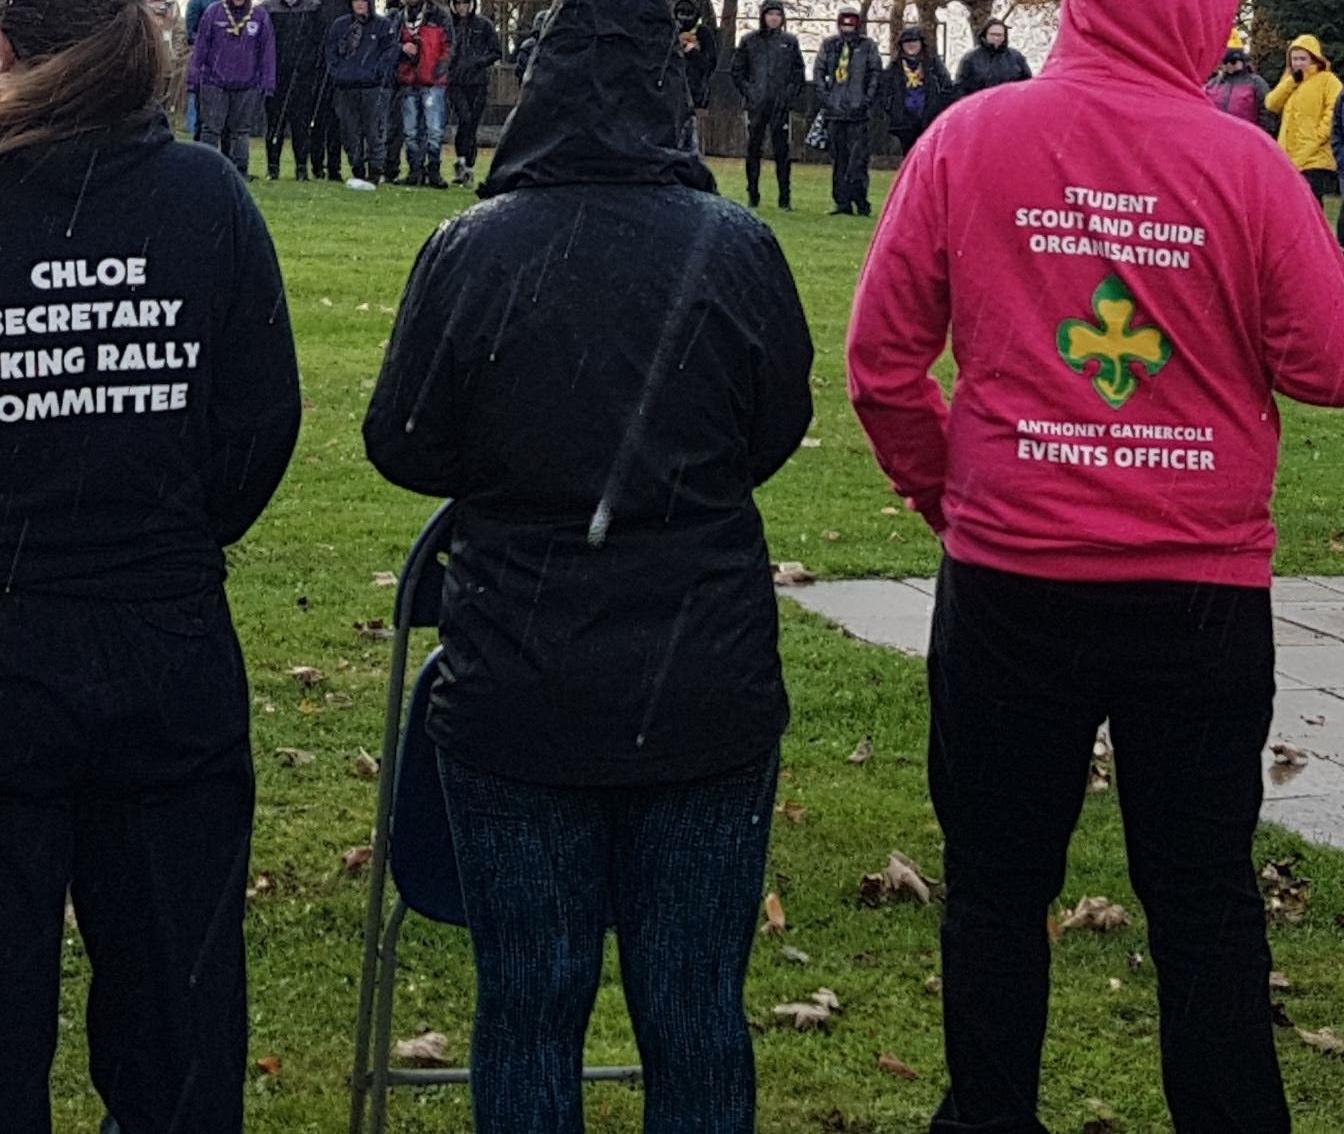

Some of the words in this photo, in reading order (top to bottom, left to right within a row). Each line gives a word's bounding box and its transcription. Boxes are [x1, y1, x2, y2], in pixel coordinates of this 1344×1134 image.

[1064, 186, 1158, 214] STUDENT
[1015, 208, 1085, 230] SCOUT
[1088, 214, 1134, 238] AND
[1138, 221, 1206, 246] GUIDE
[1029, 234, 1191, 269] ORGANISATION
[30, 257, 147, 289] CHLOE
[97, 341, 201, 371] RALLY
[1110, 423, 1214, 442] GATHERCOLE
[1018, 439, 1108, 467] EVENTS
[1114, 447, 1216, 471] OFFICER
